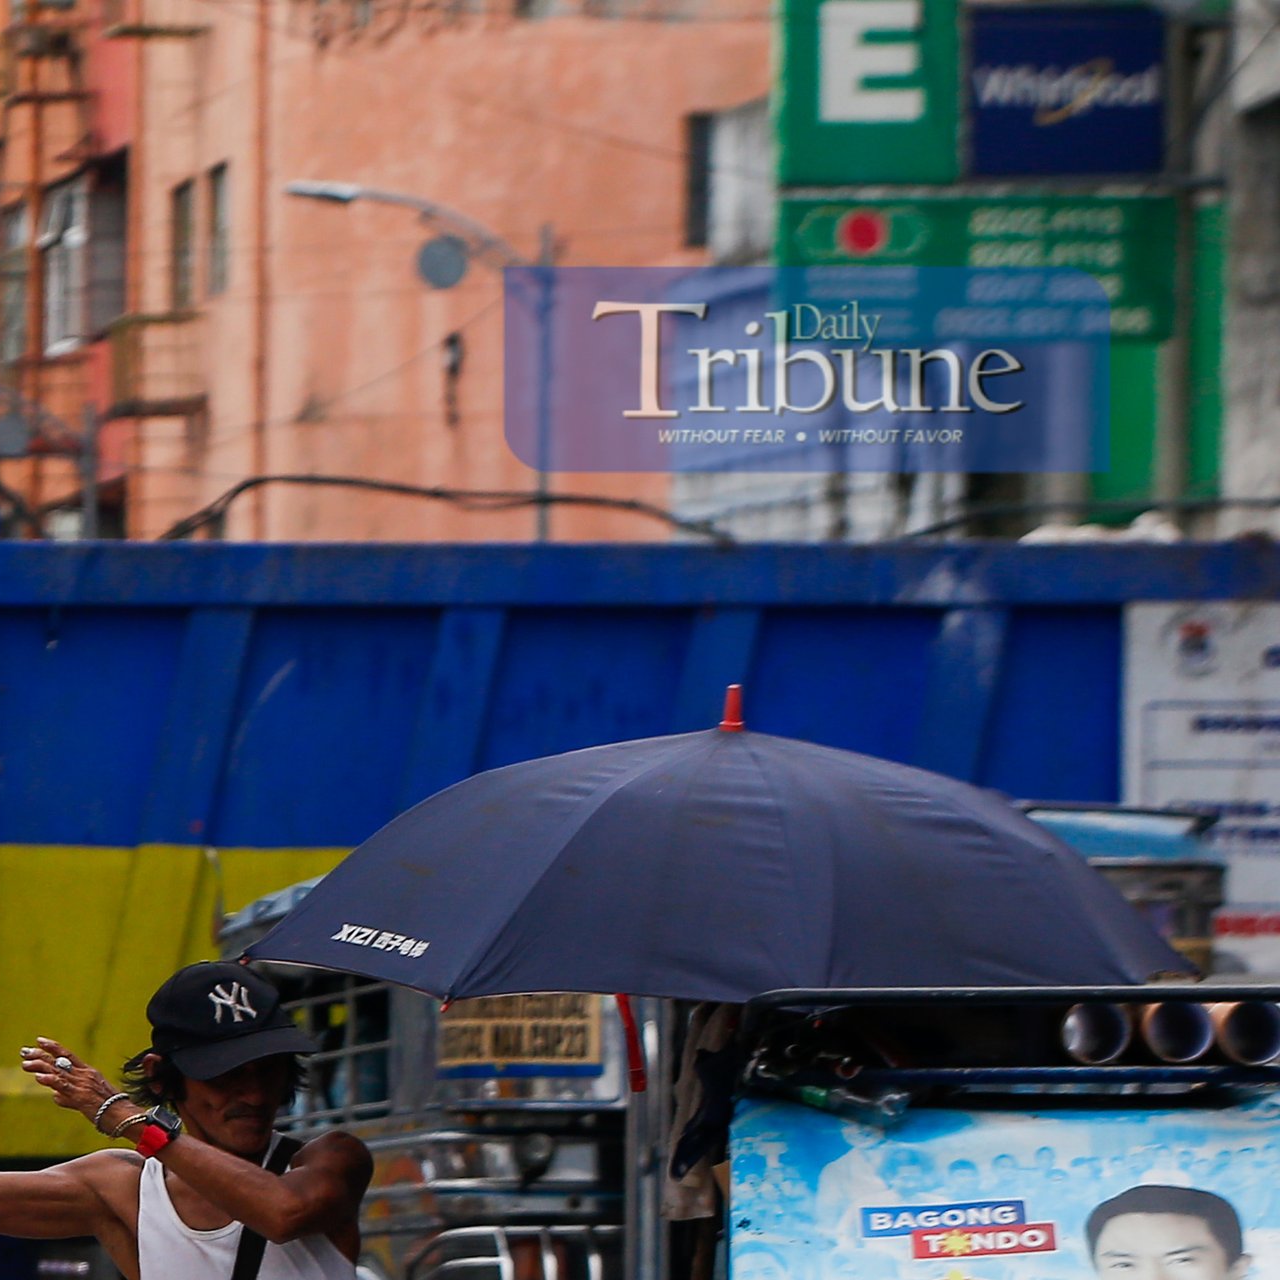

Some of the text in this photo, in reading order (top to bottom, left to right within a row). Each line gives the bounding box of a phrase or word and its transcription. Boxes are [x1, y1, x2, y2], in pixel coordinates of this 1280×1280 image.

[329, 923, 381, 947] XIZI
[209, 981, 258, 1024] NY
[869, 1205, 1019, 1231] BAGONG
